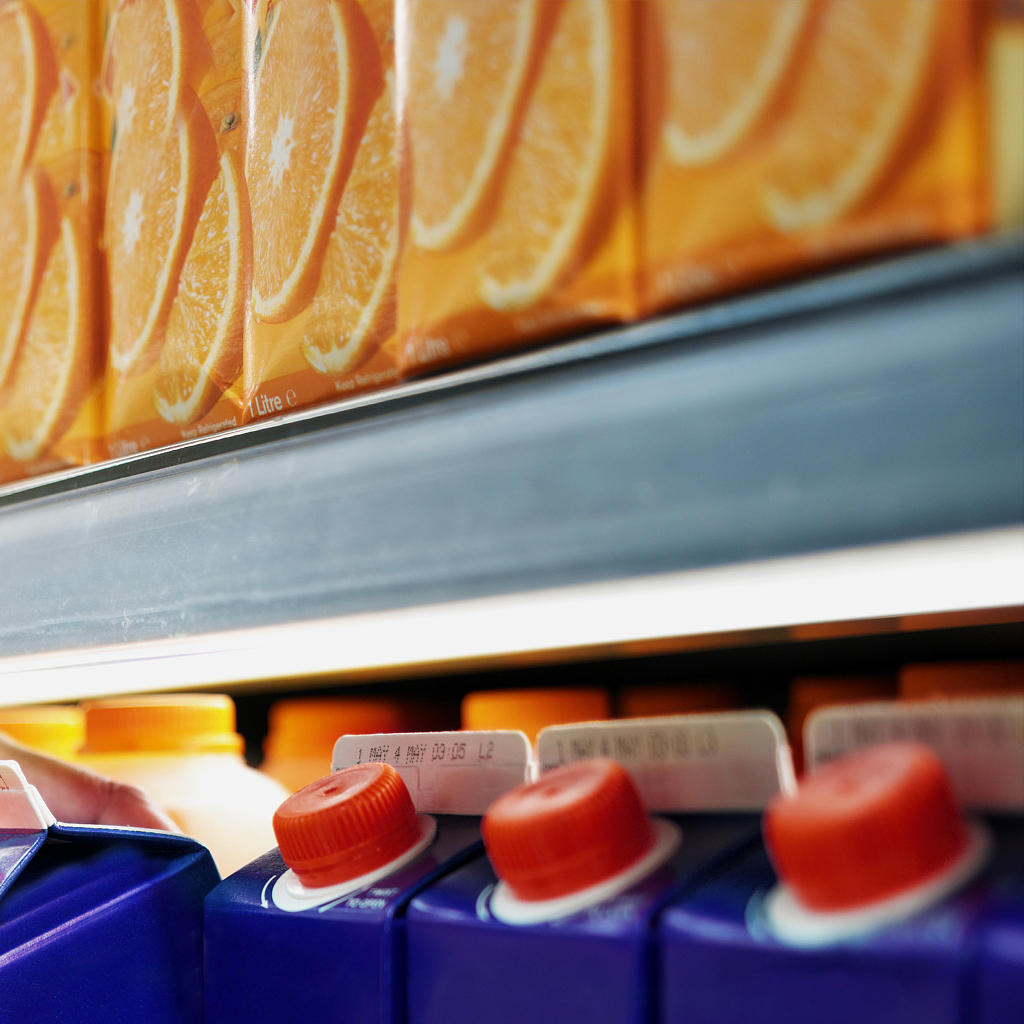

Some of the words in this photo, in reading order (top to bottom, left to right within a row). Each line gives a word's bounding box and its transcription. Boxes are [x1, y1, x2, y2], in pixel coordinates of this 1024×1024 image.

[255, 393, 283, 416] Litre
[197, 416, 238, 435] Refrigerated
[368, 744, 390, 763] MAY
[393, 746, 401, 763] 4
[405, 743, 427, 765] MAY
